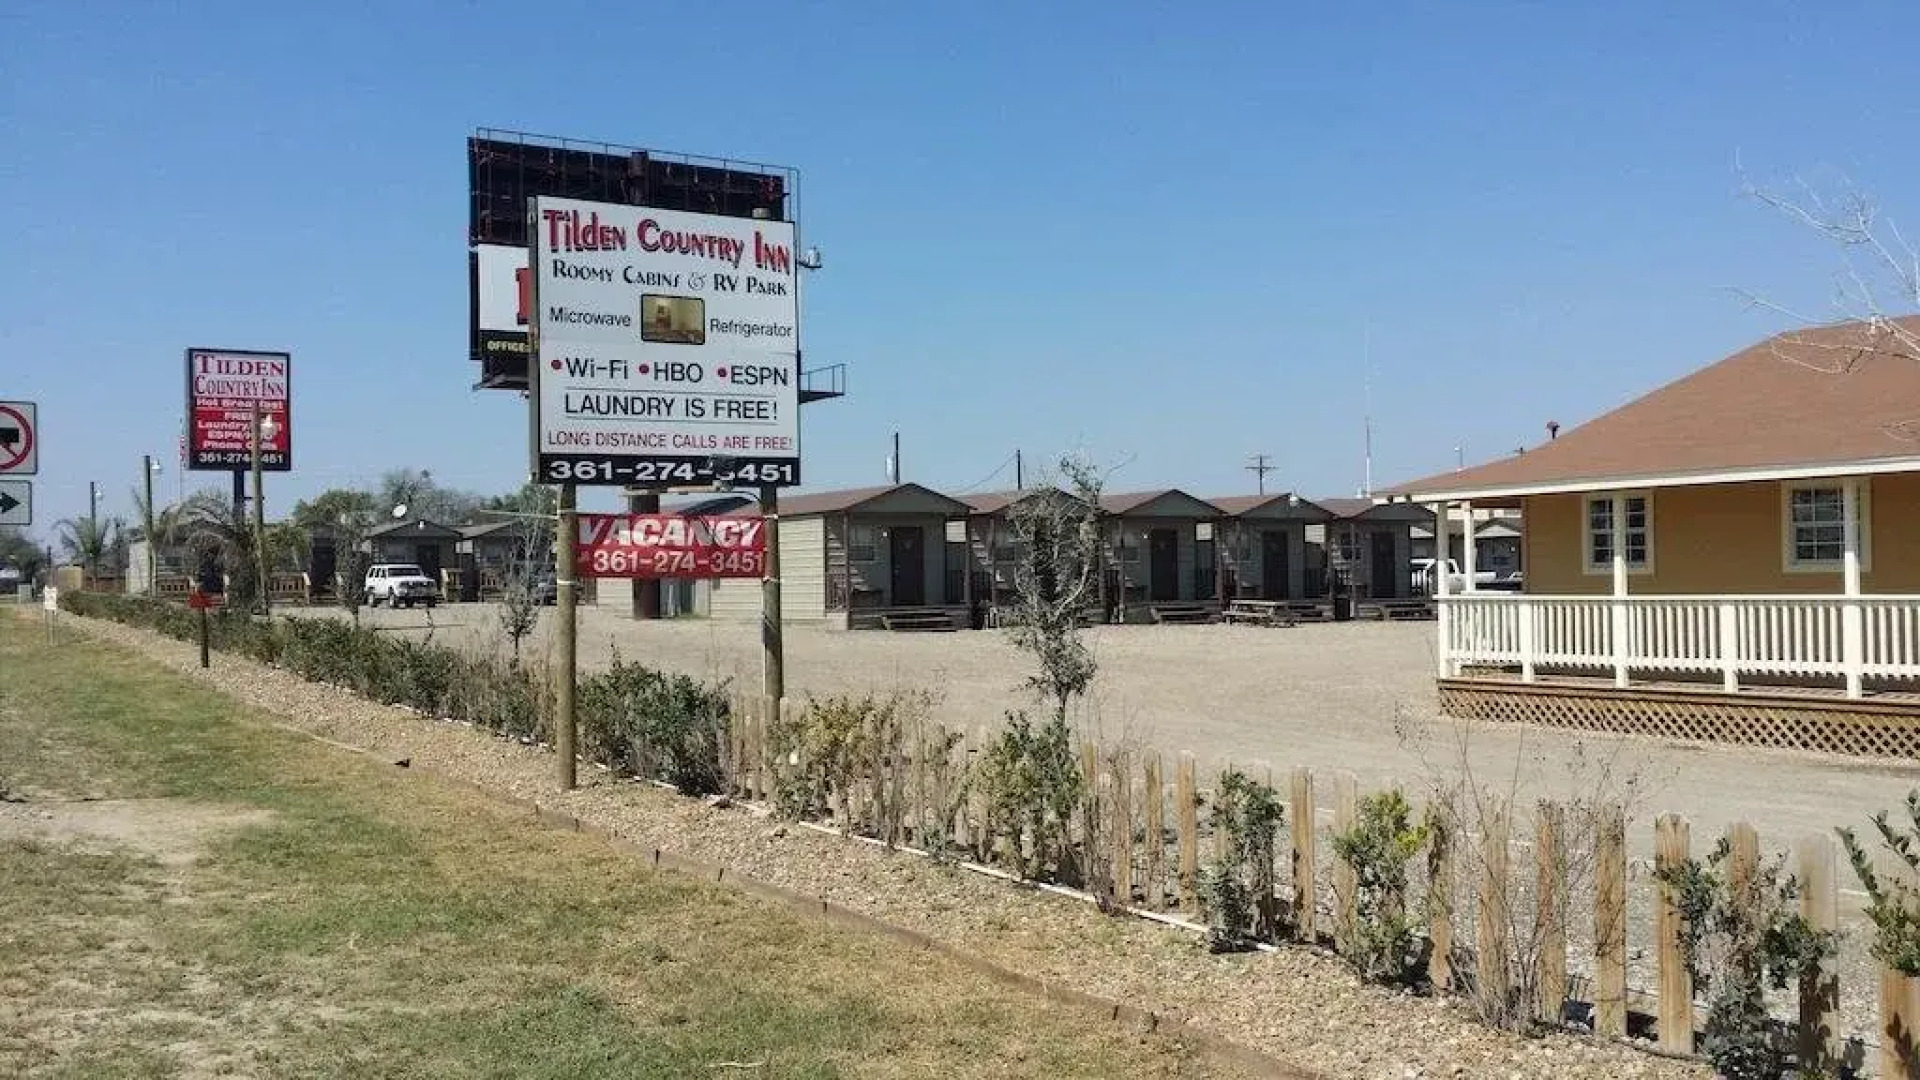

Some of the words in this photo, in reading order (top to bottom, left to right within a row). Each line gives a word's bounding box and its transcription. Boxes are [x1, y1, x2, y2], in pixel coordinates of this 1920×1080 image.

[637, 219, 745, 269] COUNTRY
[754, 231, 790, 276] INN
[552, 259, 614, 282] ROOMY
[688, 272, 706, 290] &
[713, 273, 739, 292] RV
[746, 276, 787, 296] PARK
[549, 307, 631, 327] Microwave
[710, 318, 793, 338] Refrigerator
[195, 354, 284, 377] TILDEN
[565, 357, 629, 380] Wi-Fi
[653, 362, 704, 383] HBO
[730, 365, 788, 387] ESPN
[195, 375, 259, 397] COUNTRY
[262, 378, 284, 397] INN
[196, 398, 218, 407] Hot
[221, 399, 284, 410] Breafast
[565, 393, 676, 417] LAUNDRY
[685, 398, 705, 418] IS
[713, 399, 778, 420] FREE!
[202, 440, 242, 449] Phone
[549, 431, 590, 446] LONG
[595, 432, 667, 448] DISTANCE
[672, 434, 717, 449] CALLS
[723, 436, 749, 449] ARE
[755, 437, 793, 450] FREE!
[578, 517, 763, 547] VACANCY
[593, 550, 764, 573] 361-274-3451
